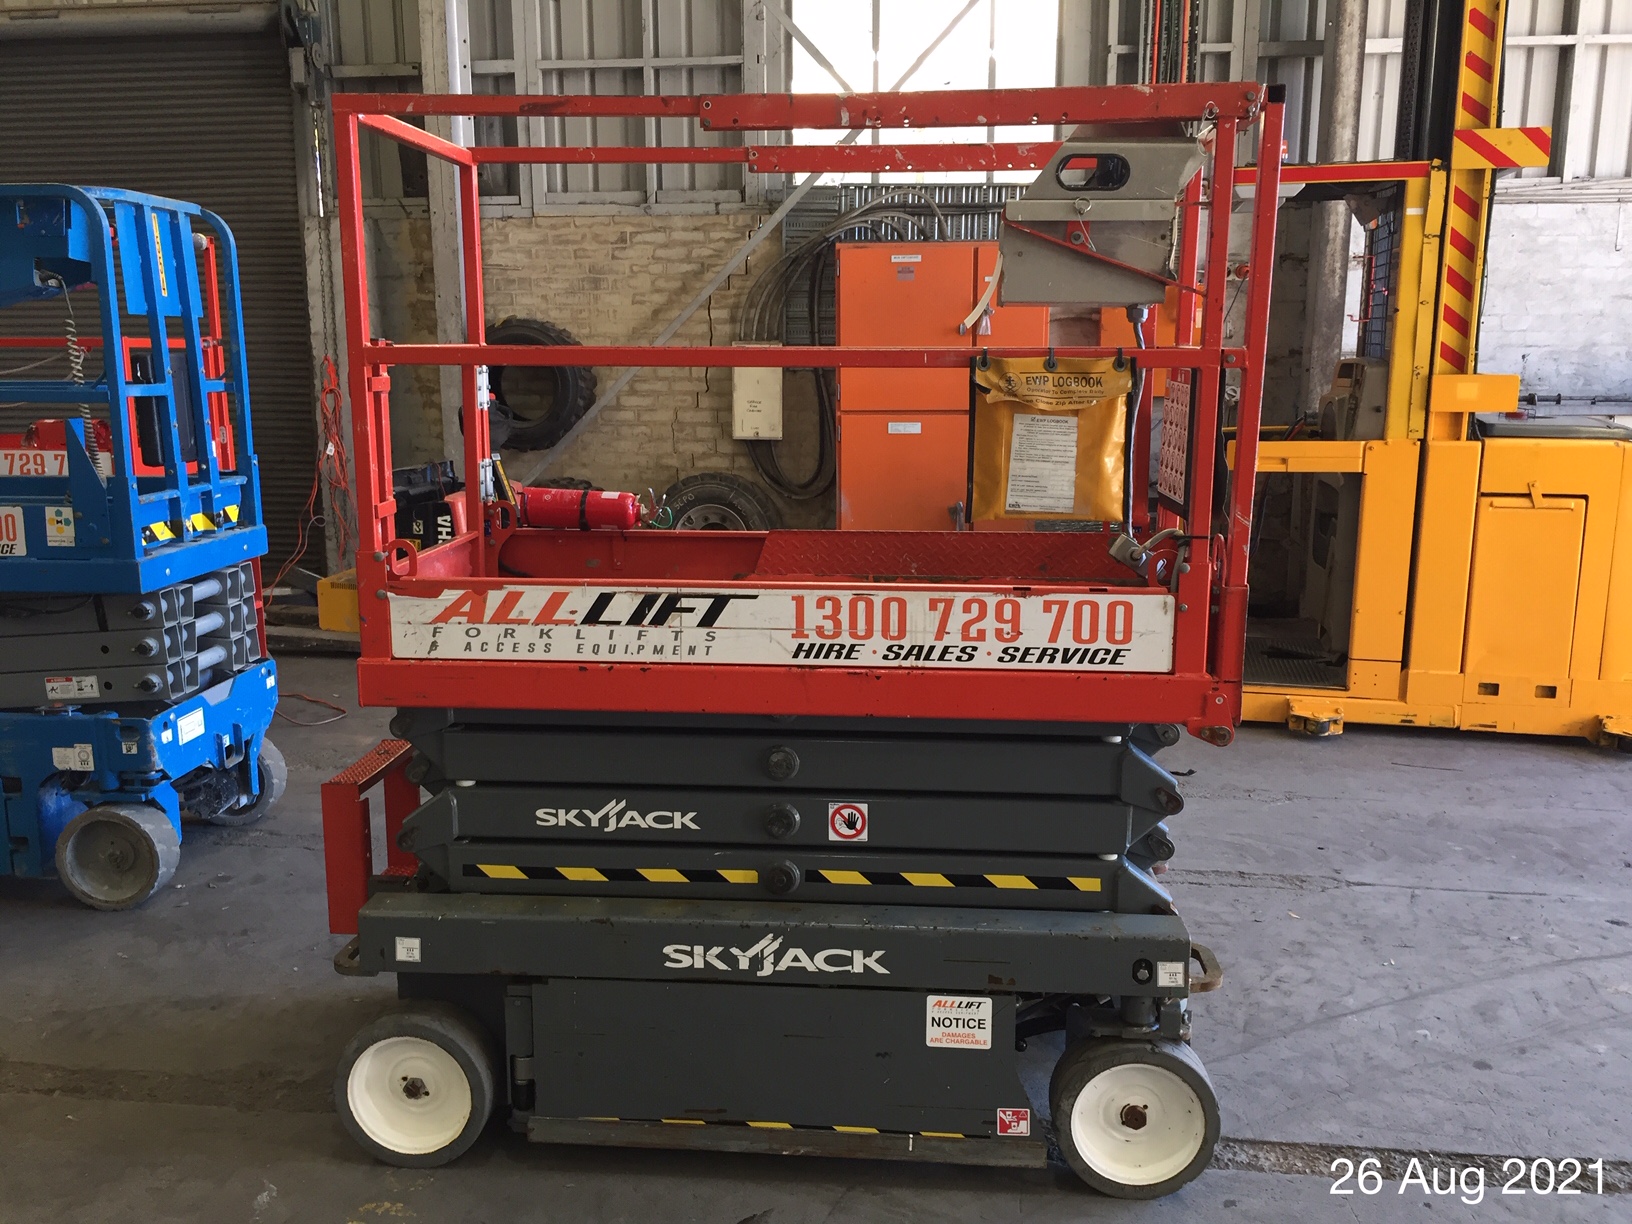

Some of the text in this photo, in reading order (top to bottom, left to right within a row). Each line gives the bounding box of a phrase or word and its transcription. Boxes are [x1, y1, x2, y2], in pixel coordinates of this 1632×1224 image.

[1025, 375, 1103, 388] EWP LOGBOOK
[3, 453, 46, 476] 729
[0, 513, 17, 542] 0
[437, 515, 452, 543] HA
[0, 543, 17, 555] CE
[790, 595, 1134, 646] 1300 729 700
[432, 626, 717, 643] FORKLIFTS
[463, 641, 553, 654] ACCESS
[577, 642, 713, 656] EQUIPMENT
[791, 642, 1131, 666] HIRE SALES SERVICE
[535, 798, 701, 833] SKYJACK
[662, 932, 890, 977] SKYJACK
[931, 1016, 987, 1030] NOTICE
[941, 1031, 976, 1039] DAMAGES
[945, 1037, 988, 1046] CHARGABLE
